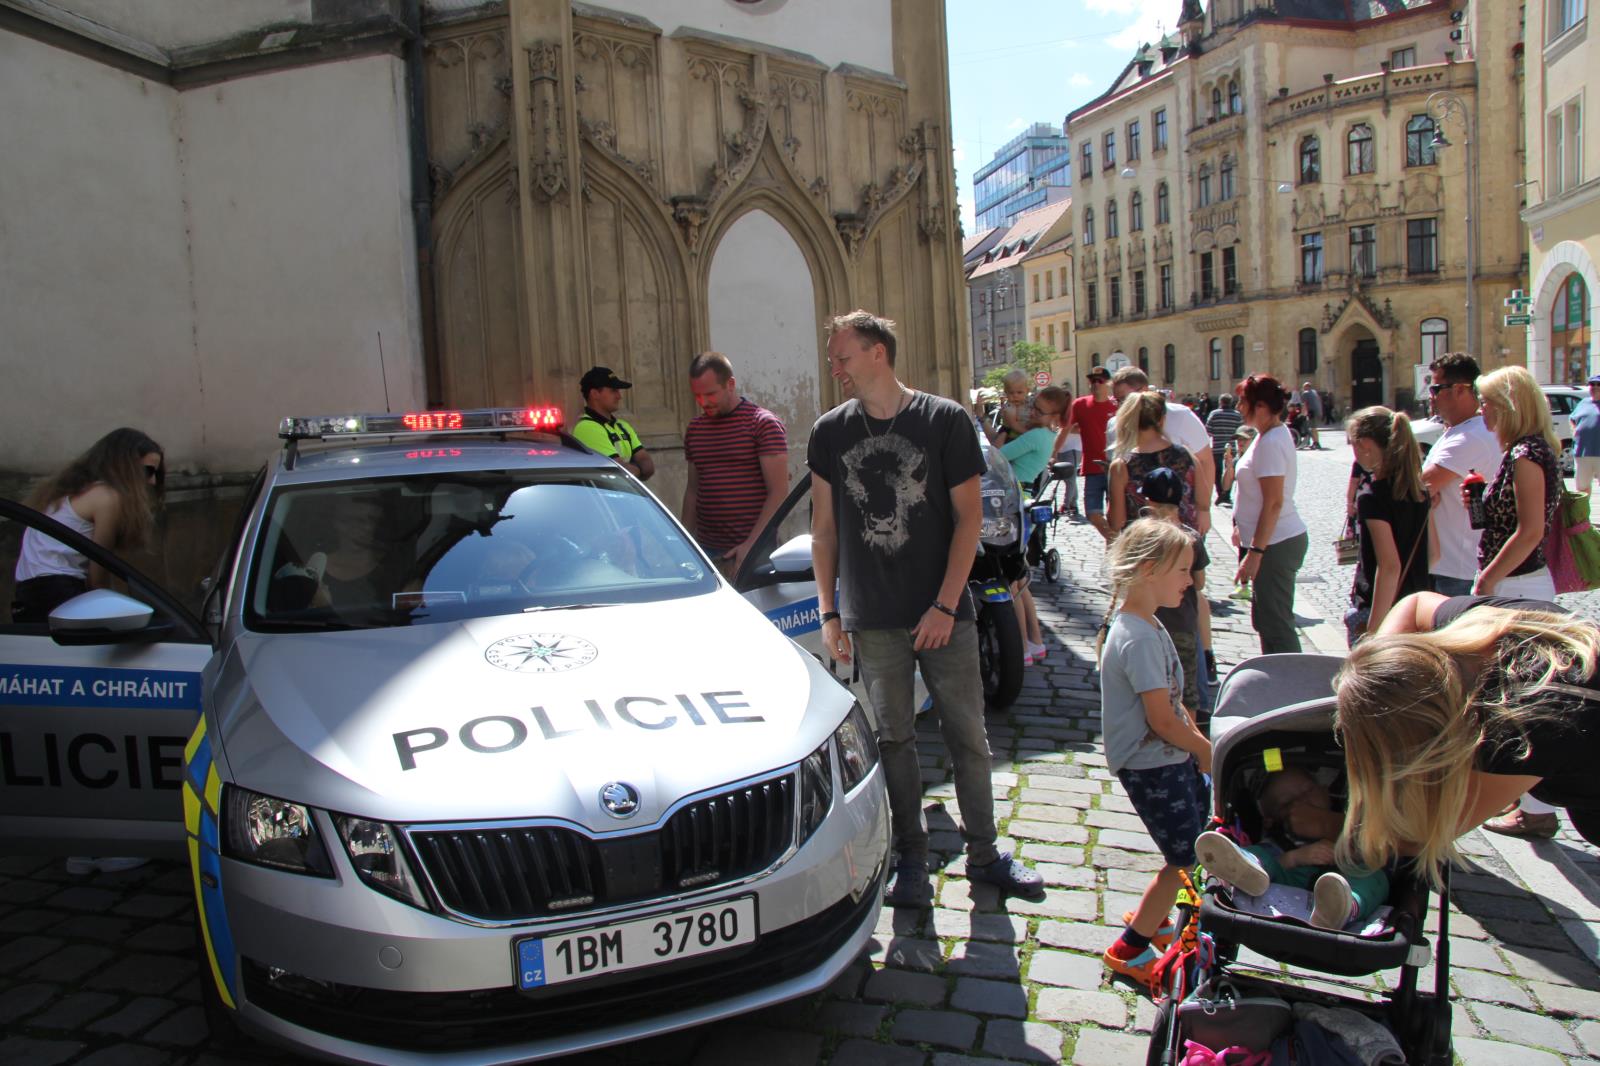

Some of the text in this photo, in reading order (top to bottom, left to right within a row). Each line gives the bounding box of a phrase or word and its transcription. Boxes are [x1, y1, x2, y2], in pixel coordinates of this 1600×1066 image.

[71, 679, 86, 696] A
[92, 677, 188, 698] CHRÁNIT
[392, 691, 765, 771] POLICIE
[556, 908, 739, 975] 1BM 3780
[524, 969, 542, 983] CZ
